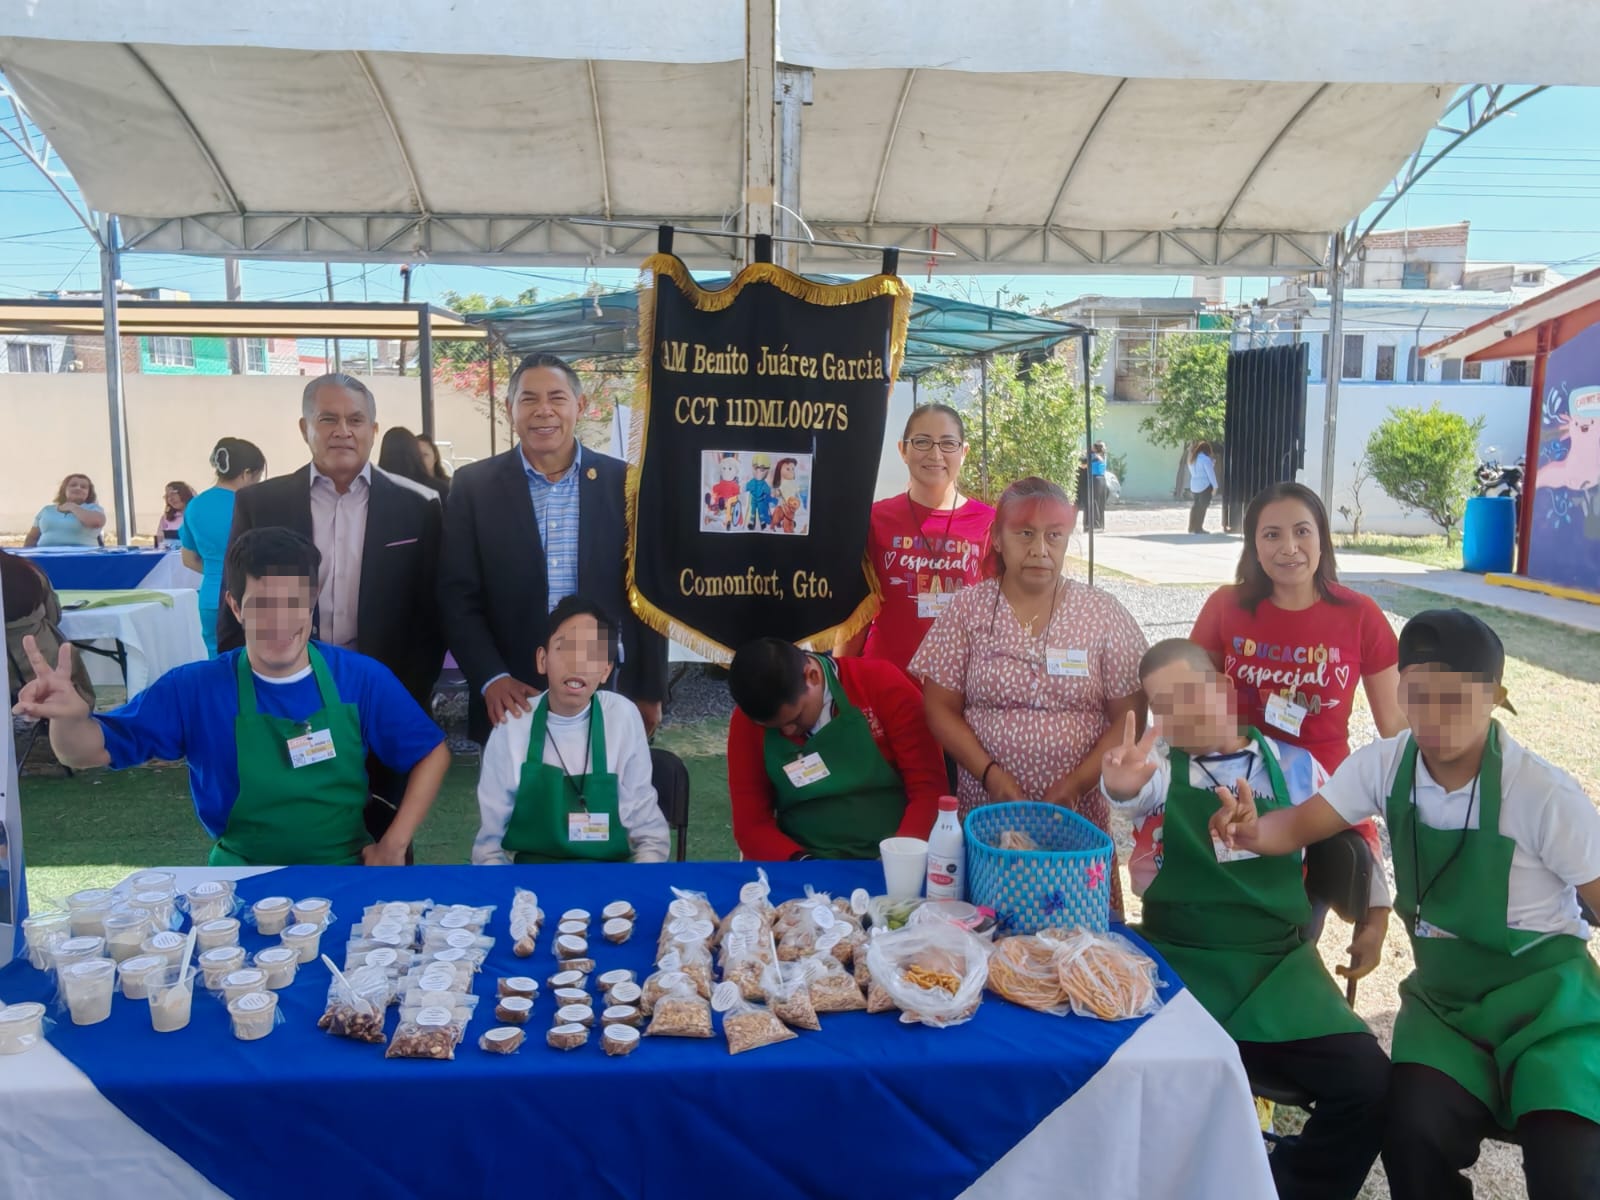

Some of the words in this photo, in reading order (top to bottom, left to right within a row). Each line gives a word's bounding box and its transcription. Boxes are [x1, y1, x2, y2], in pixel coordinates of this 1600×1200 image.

[692, 343, 749, 375] Benito
[757, 344, 818, 378] Juárez
[822, 350, 884, 381] Garcia
[674, 396, 719, 425] CCT
[725, 398, 849, 431] 11DML0027S
[900, 553, 970, 572] especial
[680, 566, 784, 600] Comonfort,
[793, 570, 833, 599] Gto.
[1233, 636, 1341, 665] EDUCACIÓN
[1237, 662, 1330, 688] especial
